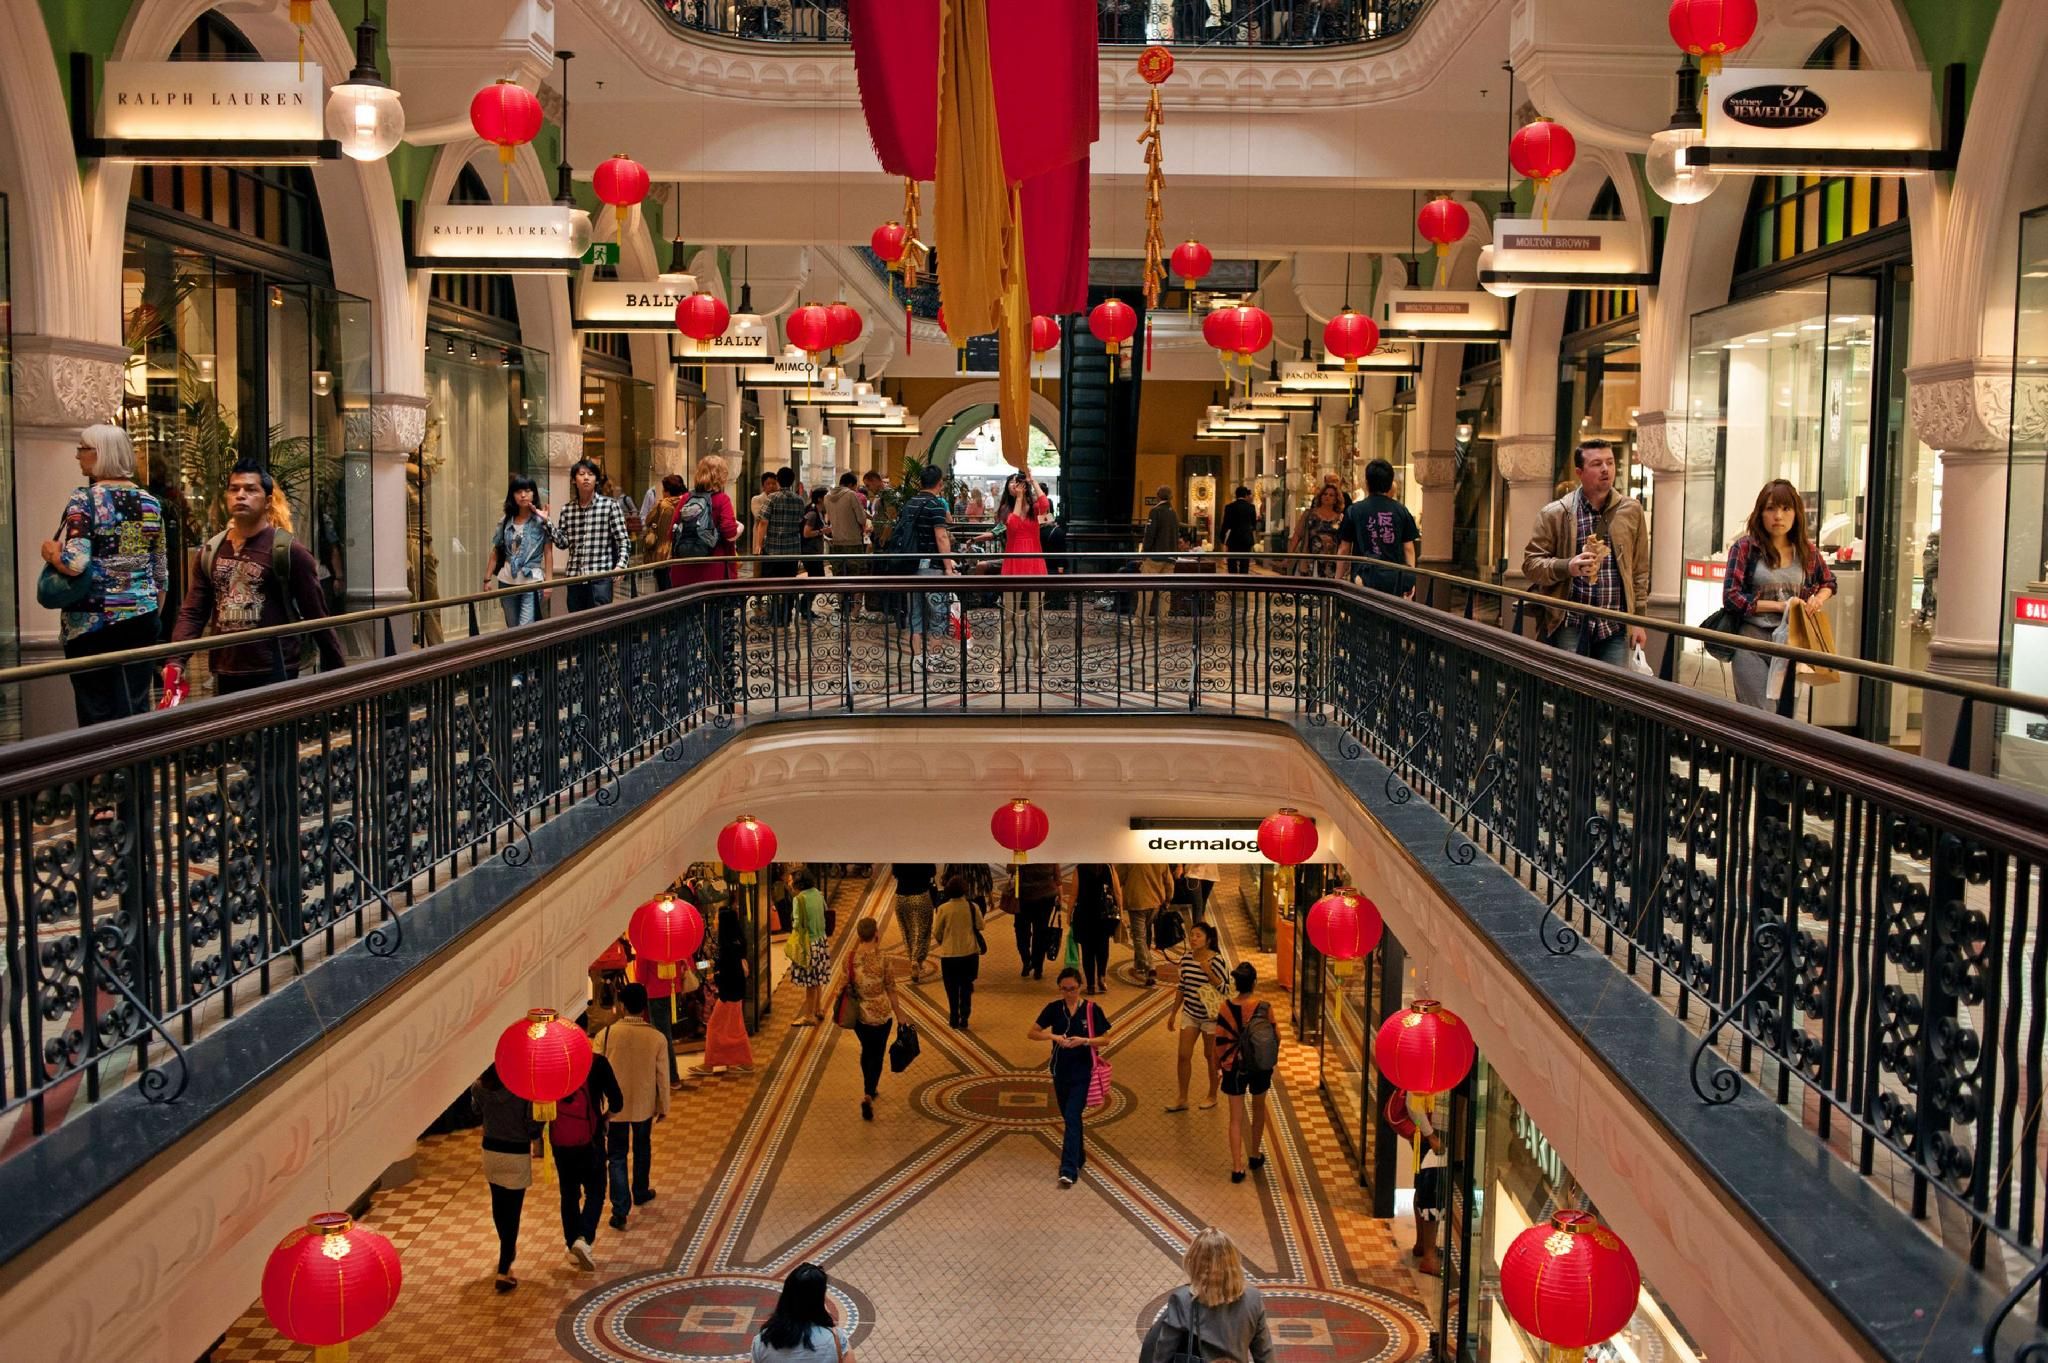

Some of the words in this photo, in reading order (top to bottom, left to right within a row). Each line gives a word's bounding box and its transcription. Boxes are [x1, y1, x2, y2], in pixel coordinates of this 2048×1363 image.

[117, 92, 193, 105] RALPH
[211, 92, 304, 106] LAUREN
[1729, 98, 1762, 107] Sydney
[1732, 105, 1824, 119] JEWELLERS
[433, 225, 484, 235] RALPH
[496, 226, 560, 235] LAUREN
[1515, 237, 1553, 248] MOLTON
[1555, 238, 1590, 249] BROWN
[626, 293, 687, 307] BALLY
[714, 335, 762, 346] BALLY
[774, 362, 814, 374] MIMCO
[1285, 370, 1329, 380] PANDORA
[2026, 602, 2047, 619] SAL
[1148, 837, 1260, 852] dermalog
